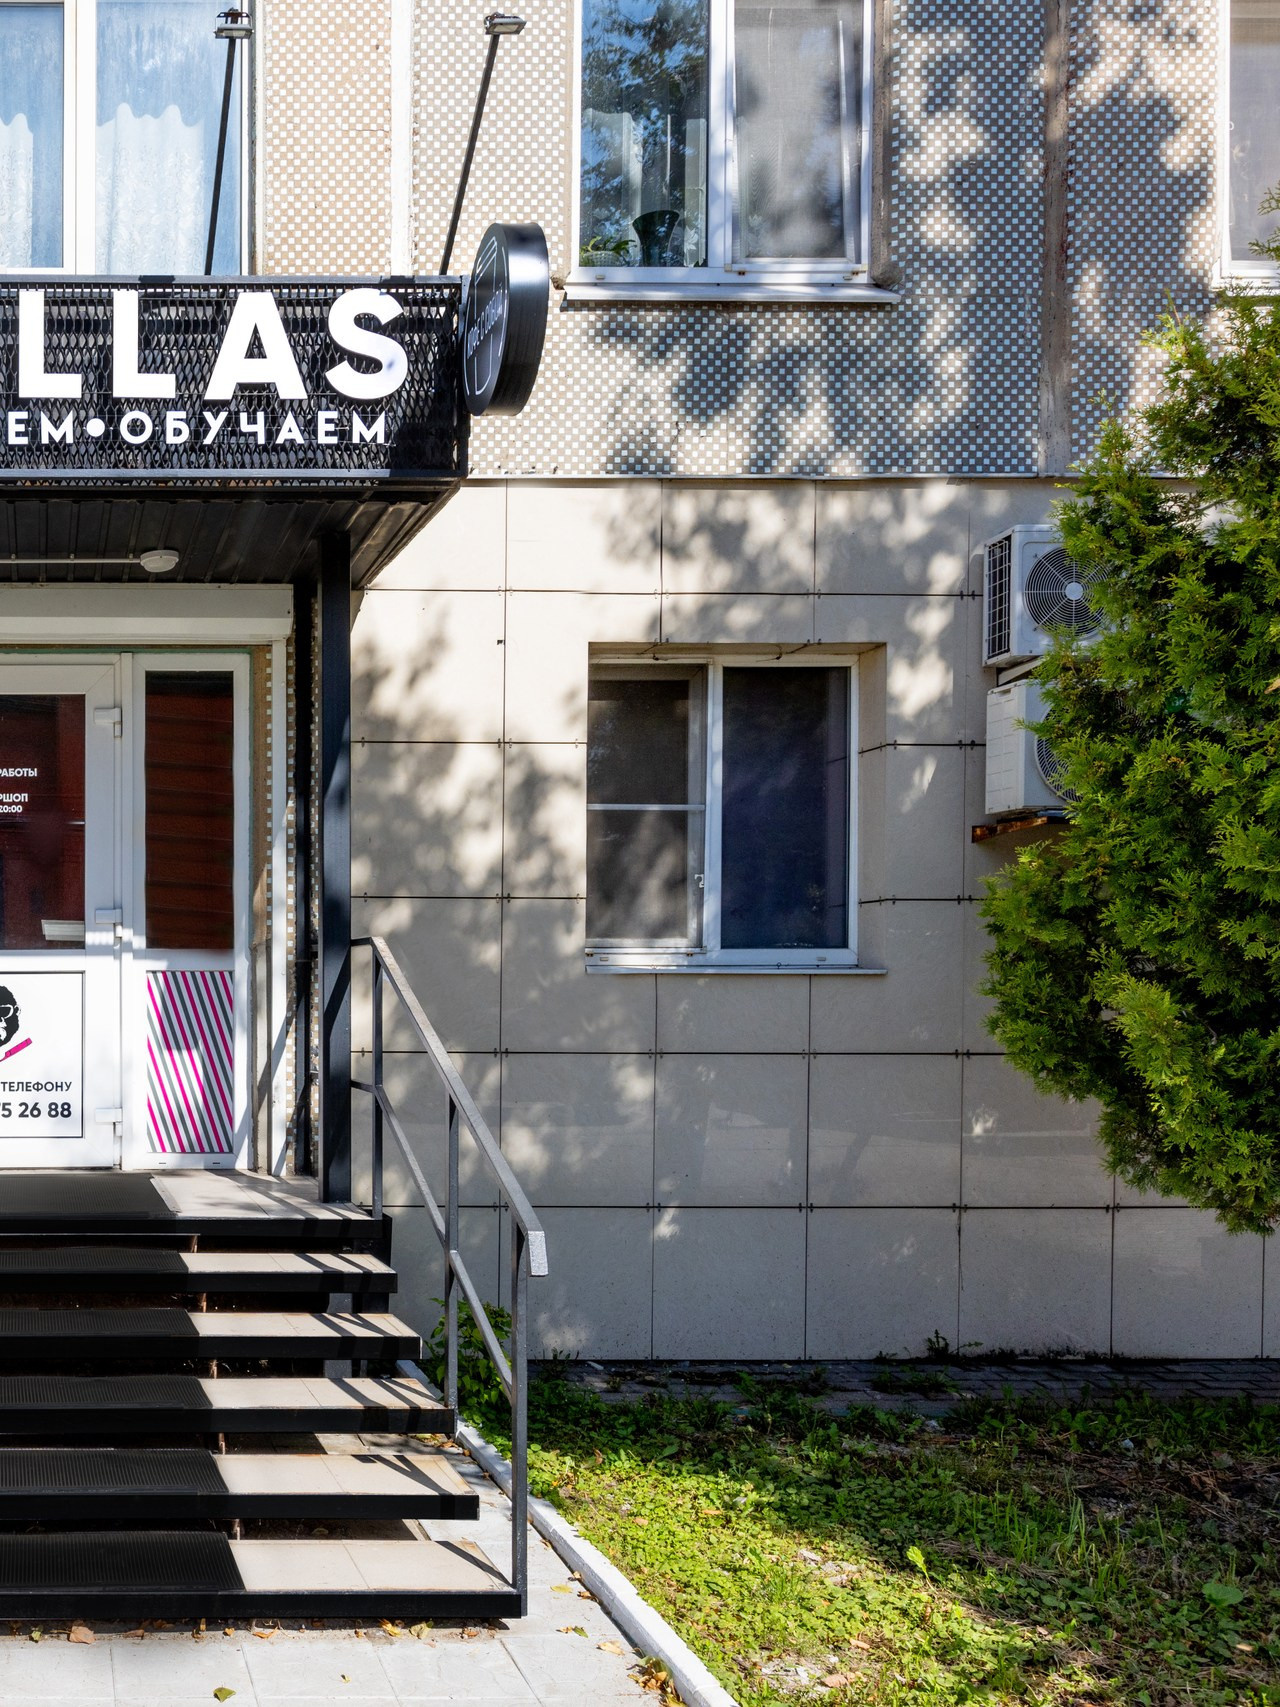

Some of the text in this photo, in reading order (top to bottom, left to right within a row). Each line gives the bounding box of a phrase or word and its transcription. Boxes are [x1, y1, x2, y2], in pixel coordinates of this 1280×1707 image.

[0, 1081, 73, 1093] ТЕЛЕФОНУ
[18, 1102, 42, 1119] 26
[47, 1102, 72, 1119] 88
